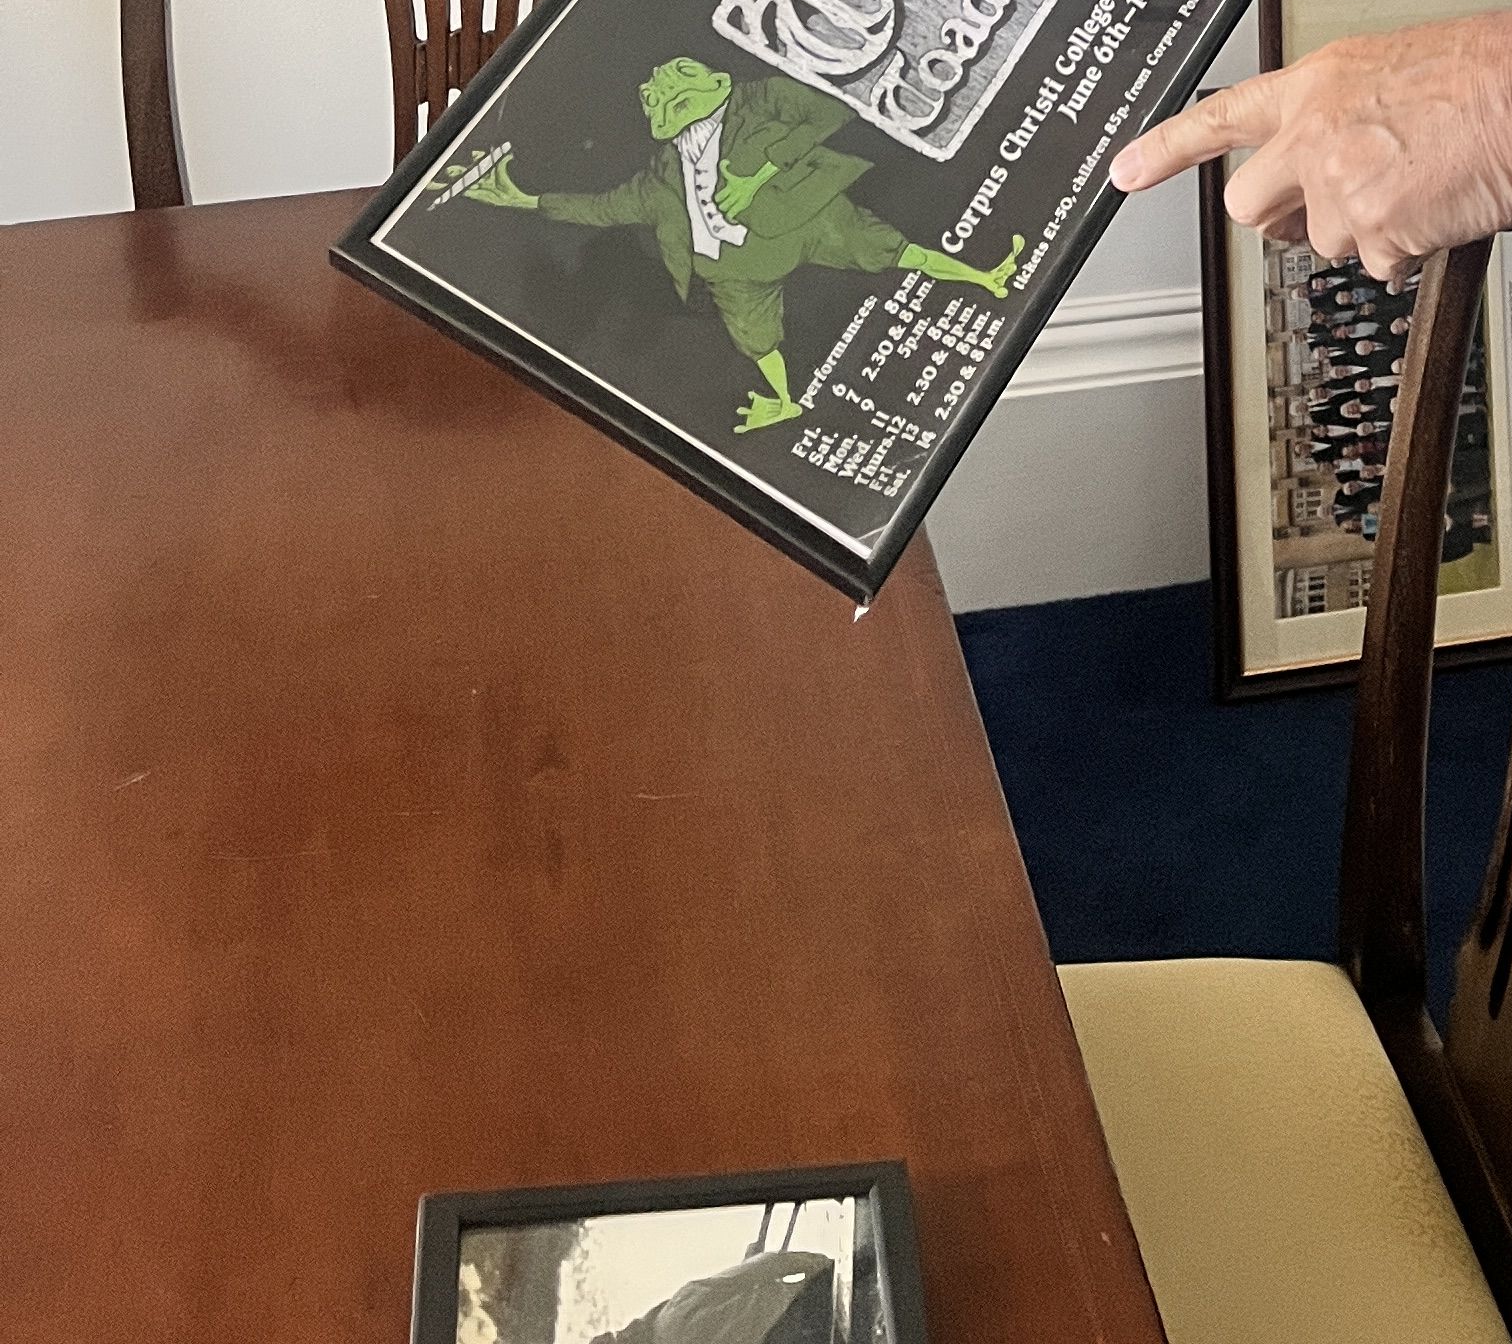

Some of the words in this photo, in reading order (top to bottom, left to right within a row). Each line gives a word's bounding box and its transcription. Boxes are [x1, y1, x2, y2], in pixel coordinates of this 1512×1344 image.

[1057, 65, 1102, 124] June
[940, 164, 1009, 254] Corpus
[999, 75, 1065, 162] Christi
[1013, 241, 1049, 291] tickets
[1072, 135, 1111, 193] children
[1124, 67, 1152, 102] from
[1145, 18, 1183, 66] Corpus
[799, 295, 878, 410] performances:
[808, 432, 839, 466] Sat.
[845, 388, 861, 404] 7
[861, 339, 893, 382] 2.30
[888, 324, 907, 341] &
[886, 415, 906, 435] 12
[906, 365, 938, 406] 2.30
[931, 349, 949, 366] &
[791, 427, 821, 458] Fri.
[832, 383, 846, 397] 6
[822, 434, 858, 474] Mon.
[860, 398, 875, 412] 9
[838, 439, 874, 478] Wed.
[870, 410, 890, 428] 11
[883, 469, 912, 497] Sat.
[916, 431, 937, 449] 14
[935, 380, 966, 421] 2.30
[960, 365, 977, 380] &
[901, 423, 920, 442] 13
